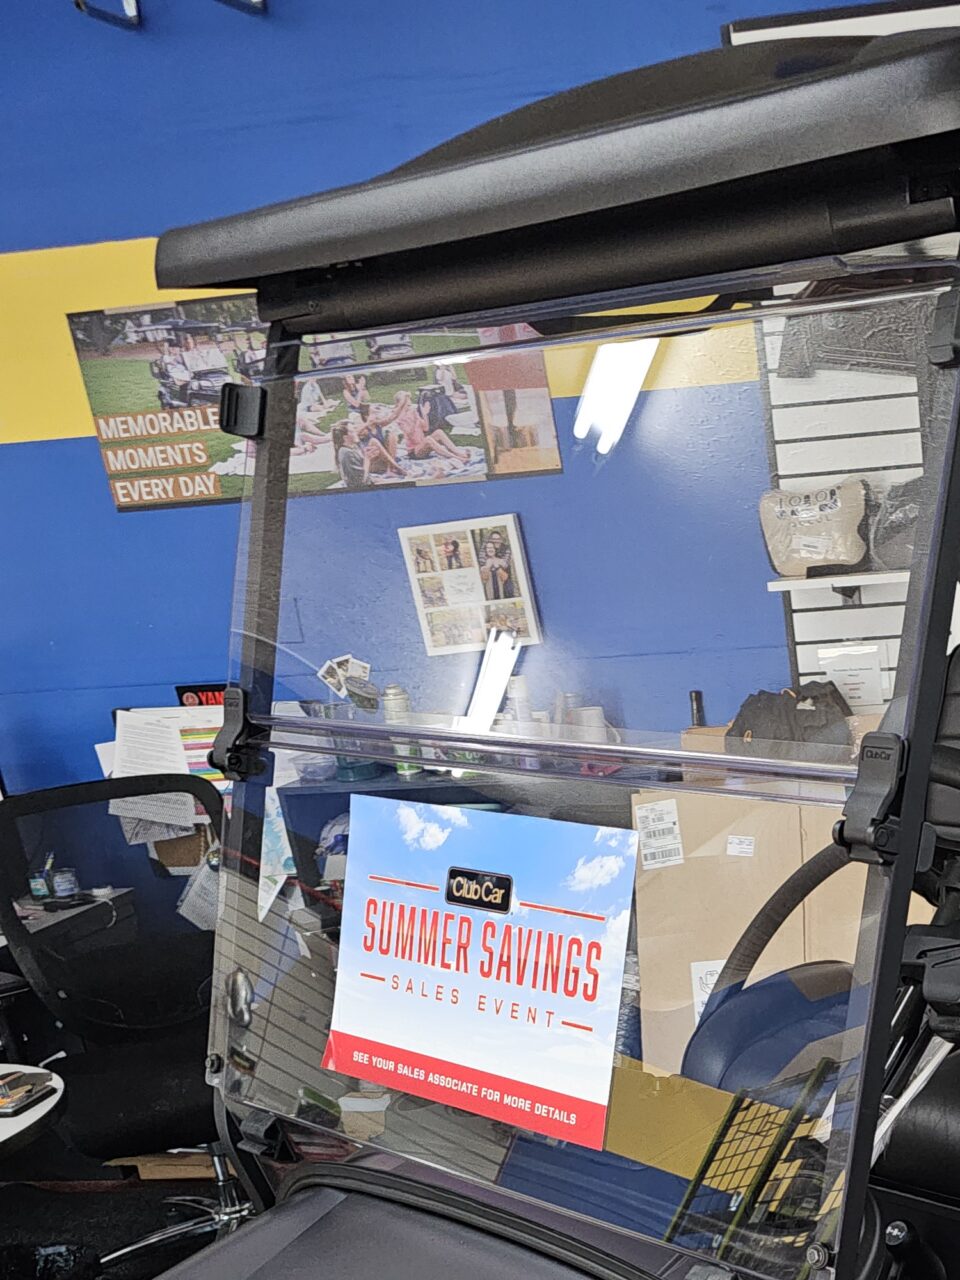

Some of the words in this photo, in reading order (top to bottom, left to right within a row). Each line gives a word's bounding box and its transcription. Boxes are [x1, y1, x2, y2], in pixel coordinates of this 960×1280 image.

[98, 407, 220, 440] MEMORABLE
[106, 442, 208, 472] MOMENTS
[114, 478, 175, 503] EVERY
[179, 474, 216, 498] DAY
[452, 875, 482, 902] Club
[481, 881, 506, 905] Car
[363, 898, 473, 974] SUMMER
[479, 919, 602, 1003] SAVINGS
[391, 974, 460, 1005] SALES
[477, 994, 555, 1028] EVENT
[352, 1050, 370, 1065] SEE
[371, 1055, 395, 1072] YOUR
[397, 1063, 425, 1081] SALES
[427, 1072, 479, 1097] ASSOCIATE
[481, 1087, 501, 1103] FOR
[503, 1093, 532, 1112] MORE
[534, 1102, 578, 1126] DETAILS
